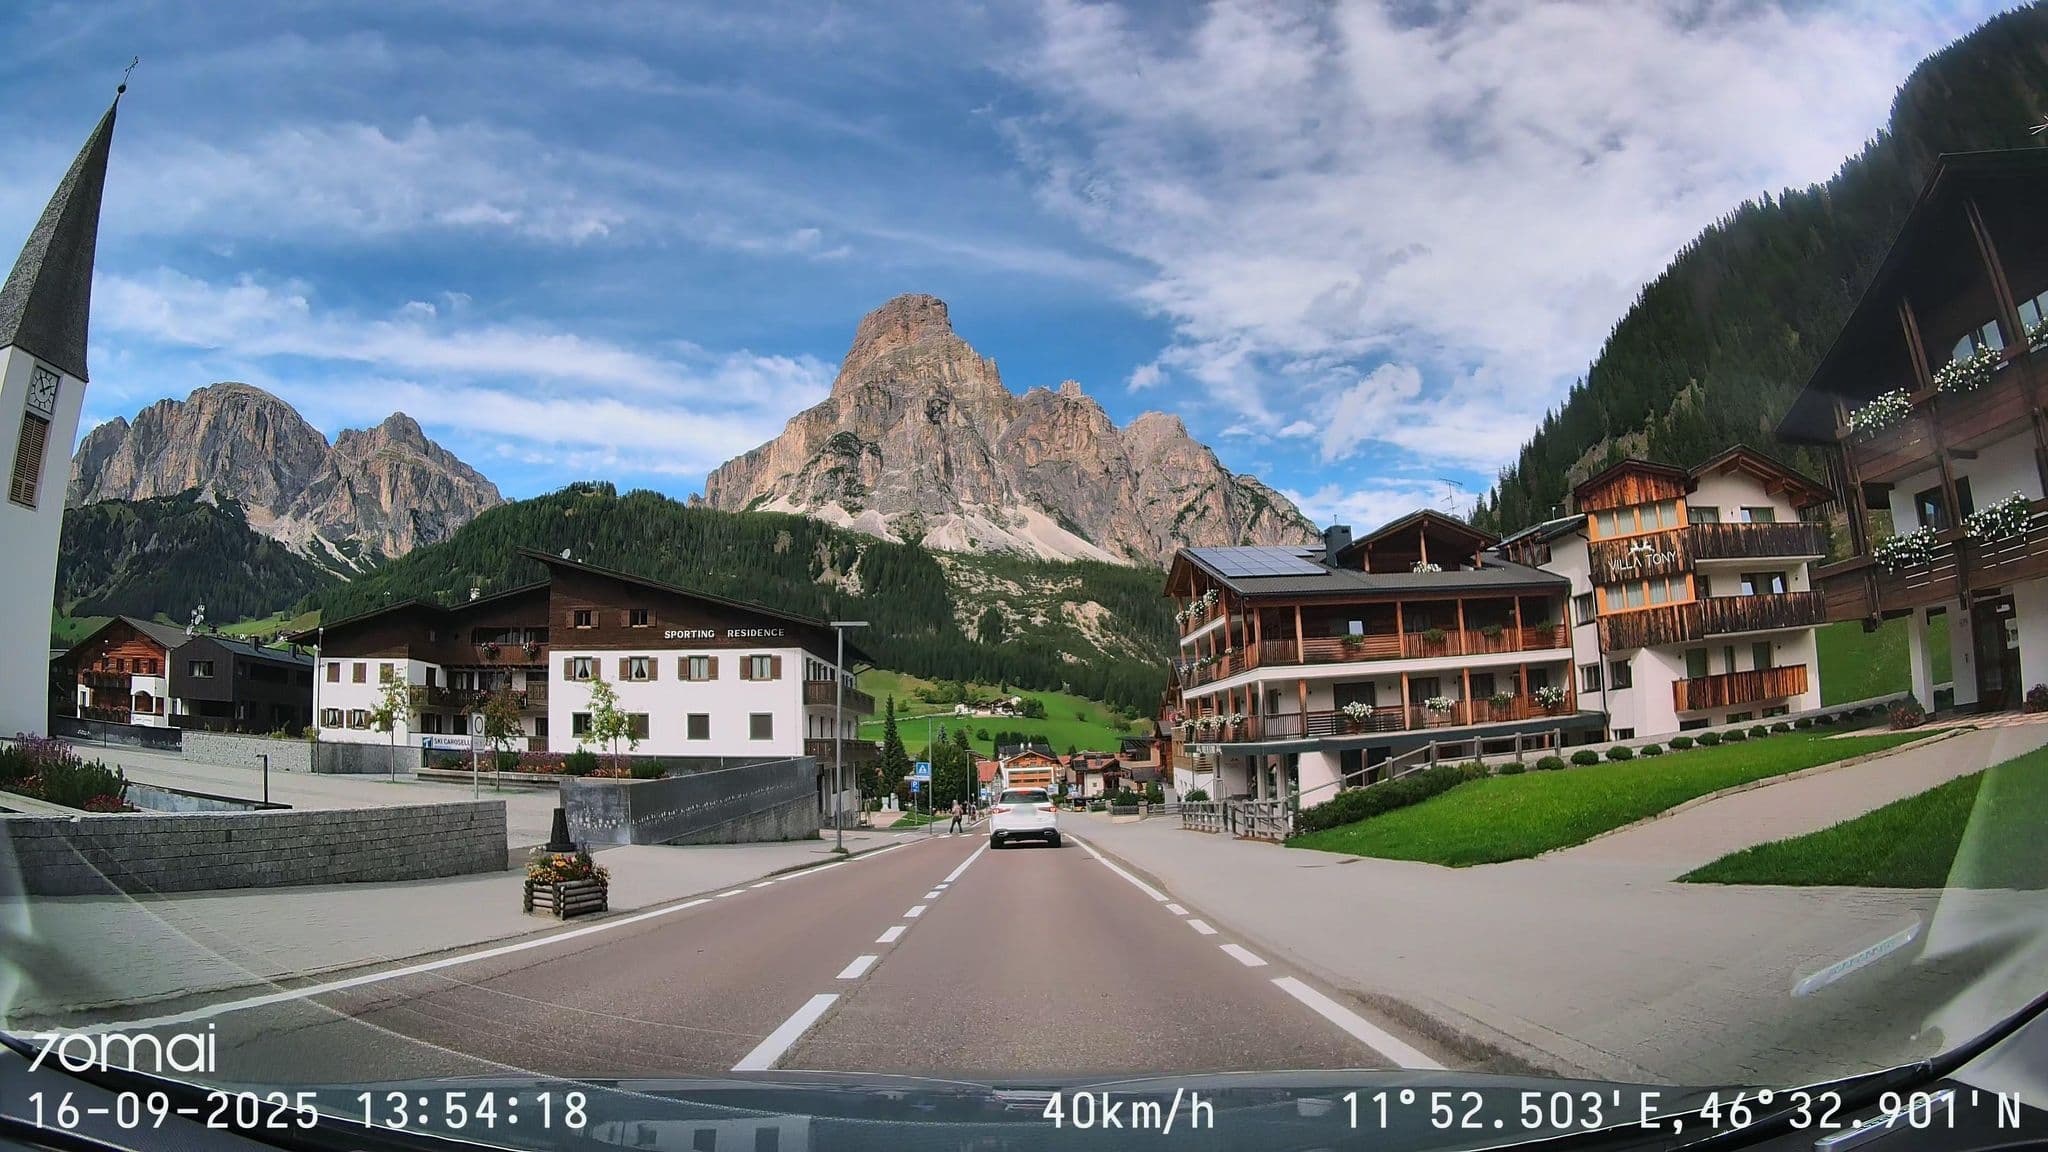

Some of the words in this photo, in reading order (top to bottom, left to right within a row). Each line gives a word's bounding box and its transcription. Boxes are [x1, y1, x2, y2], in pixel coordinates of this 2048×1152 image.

[1607, 556, 1642, 571] VILLA
[1646, 551, 1676, 569] TONY
[664, 629, 715, 639] SPORTING
[727, 628, 785, 638] RESIDENCE
[444, 738, 472, 746] CAROSELL
